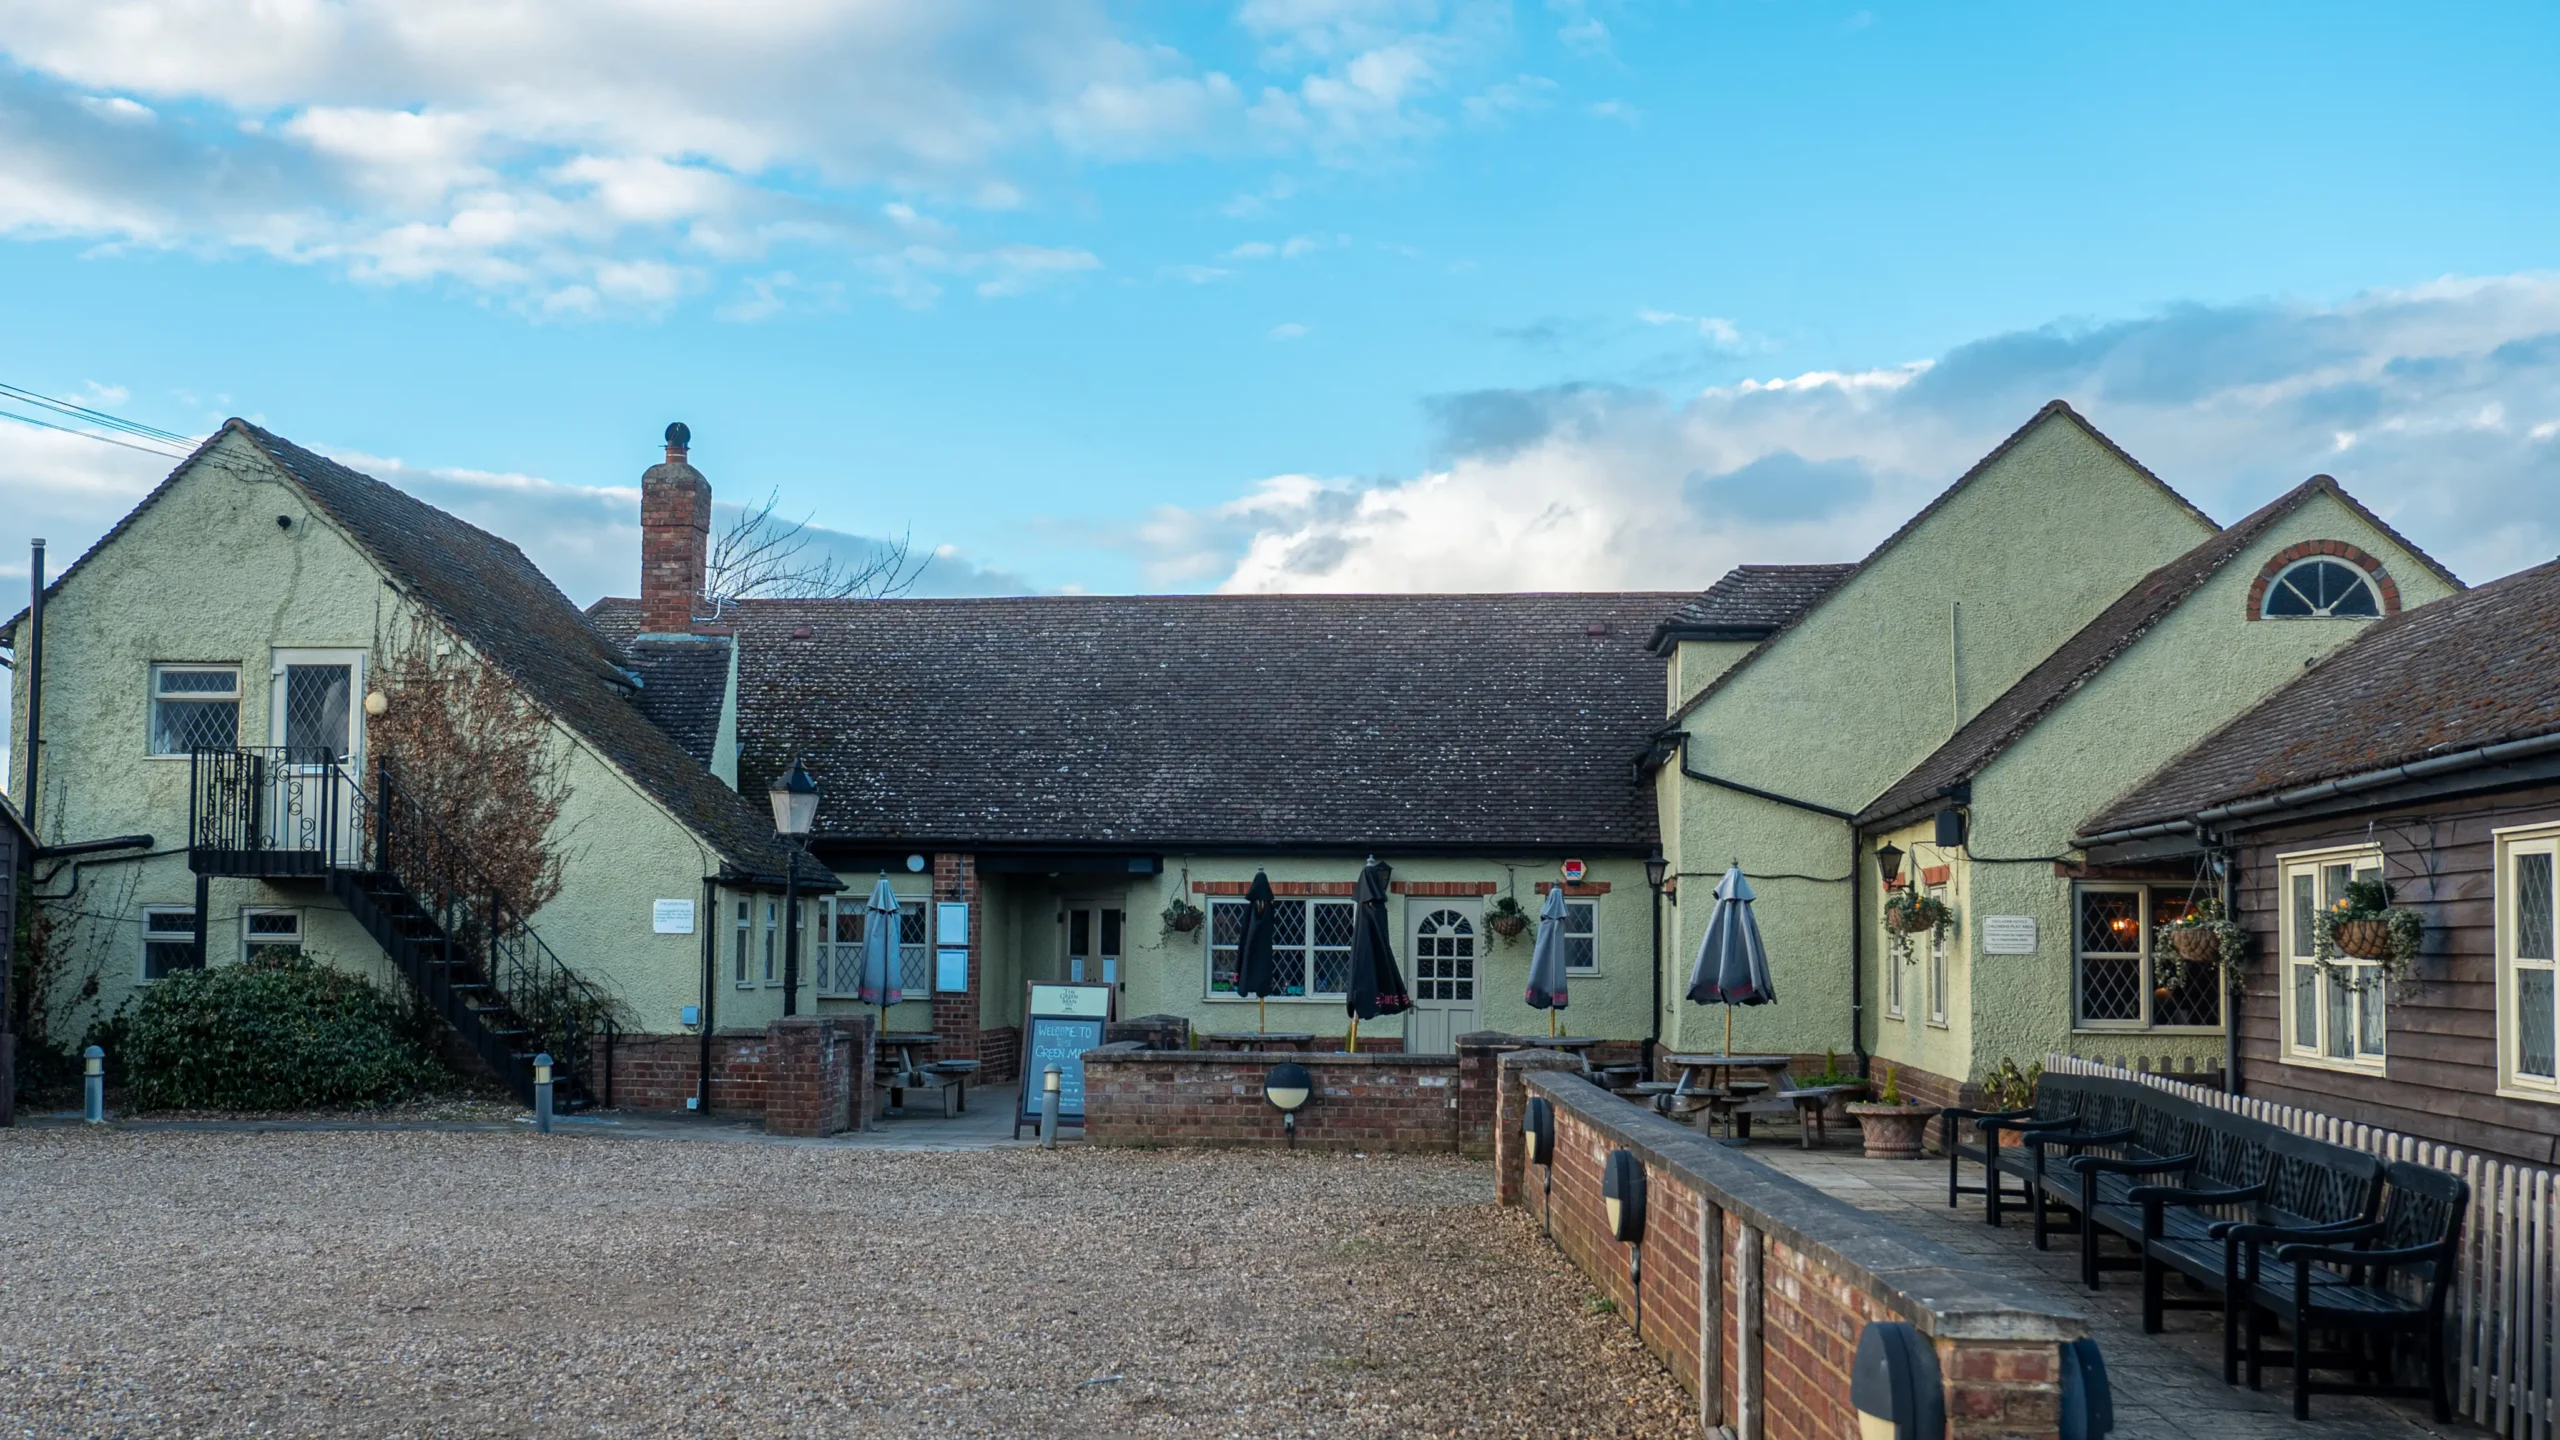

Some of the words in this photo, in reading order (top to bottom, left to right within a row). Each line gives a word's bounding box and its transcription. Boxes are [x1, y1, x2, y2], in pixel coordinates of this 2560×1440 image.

[1038, 1025, 1076, 1038] WELCOME
[1079, 1026, 1092, 1038] TO
[1035, 1045, 1064, 1060] GREEN
